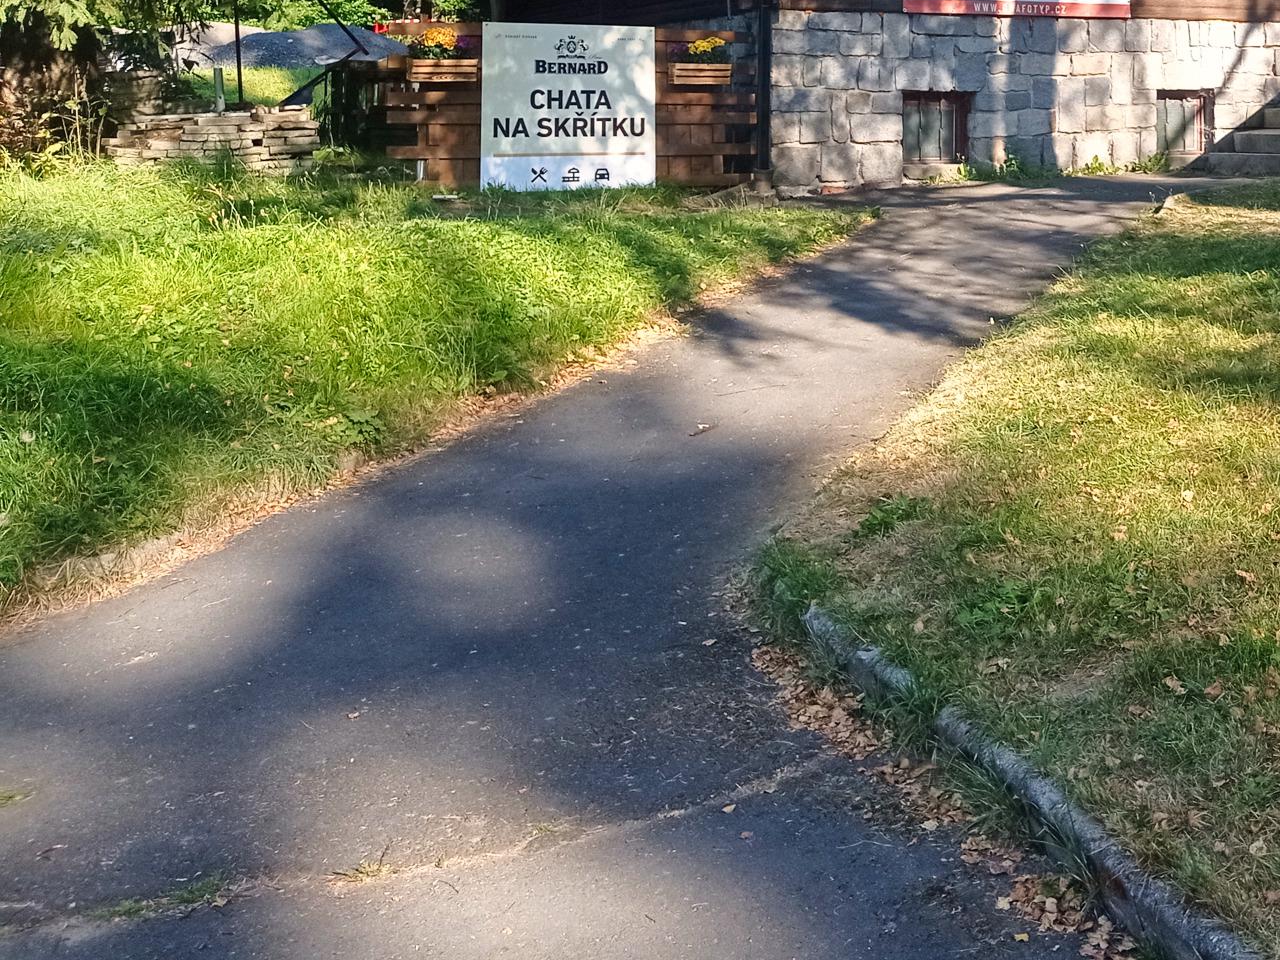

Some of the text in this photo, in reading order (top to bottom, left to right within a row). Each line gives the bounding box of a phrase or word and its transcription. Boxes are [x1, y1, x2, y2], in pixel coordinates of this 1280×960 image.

[973, 2, 1068, 16] WWW.AFOTYP.CZ
[534, 59, 609, 75] BERNARD
[530, 89, 612, 110] CHATA
[493, 112, 646, 138] NA SKŘÍTKU
